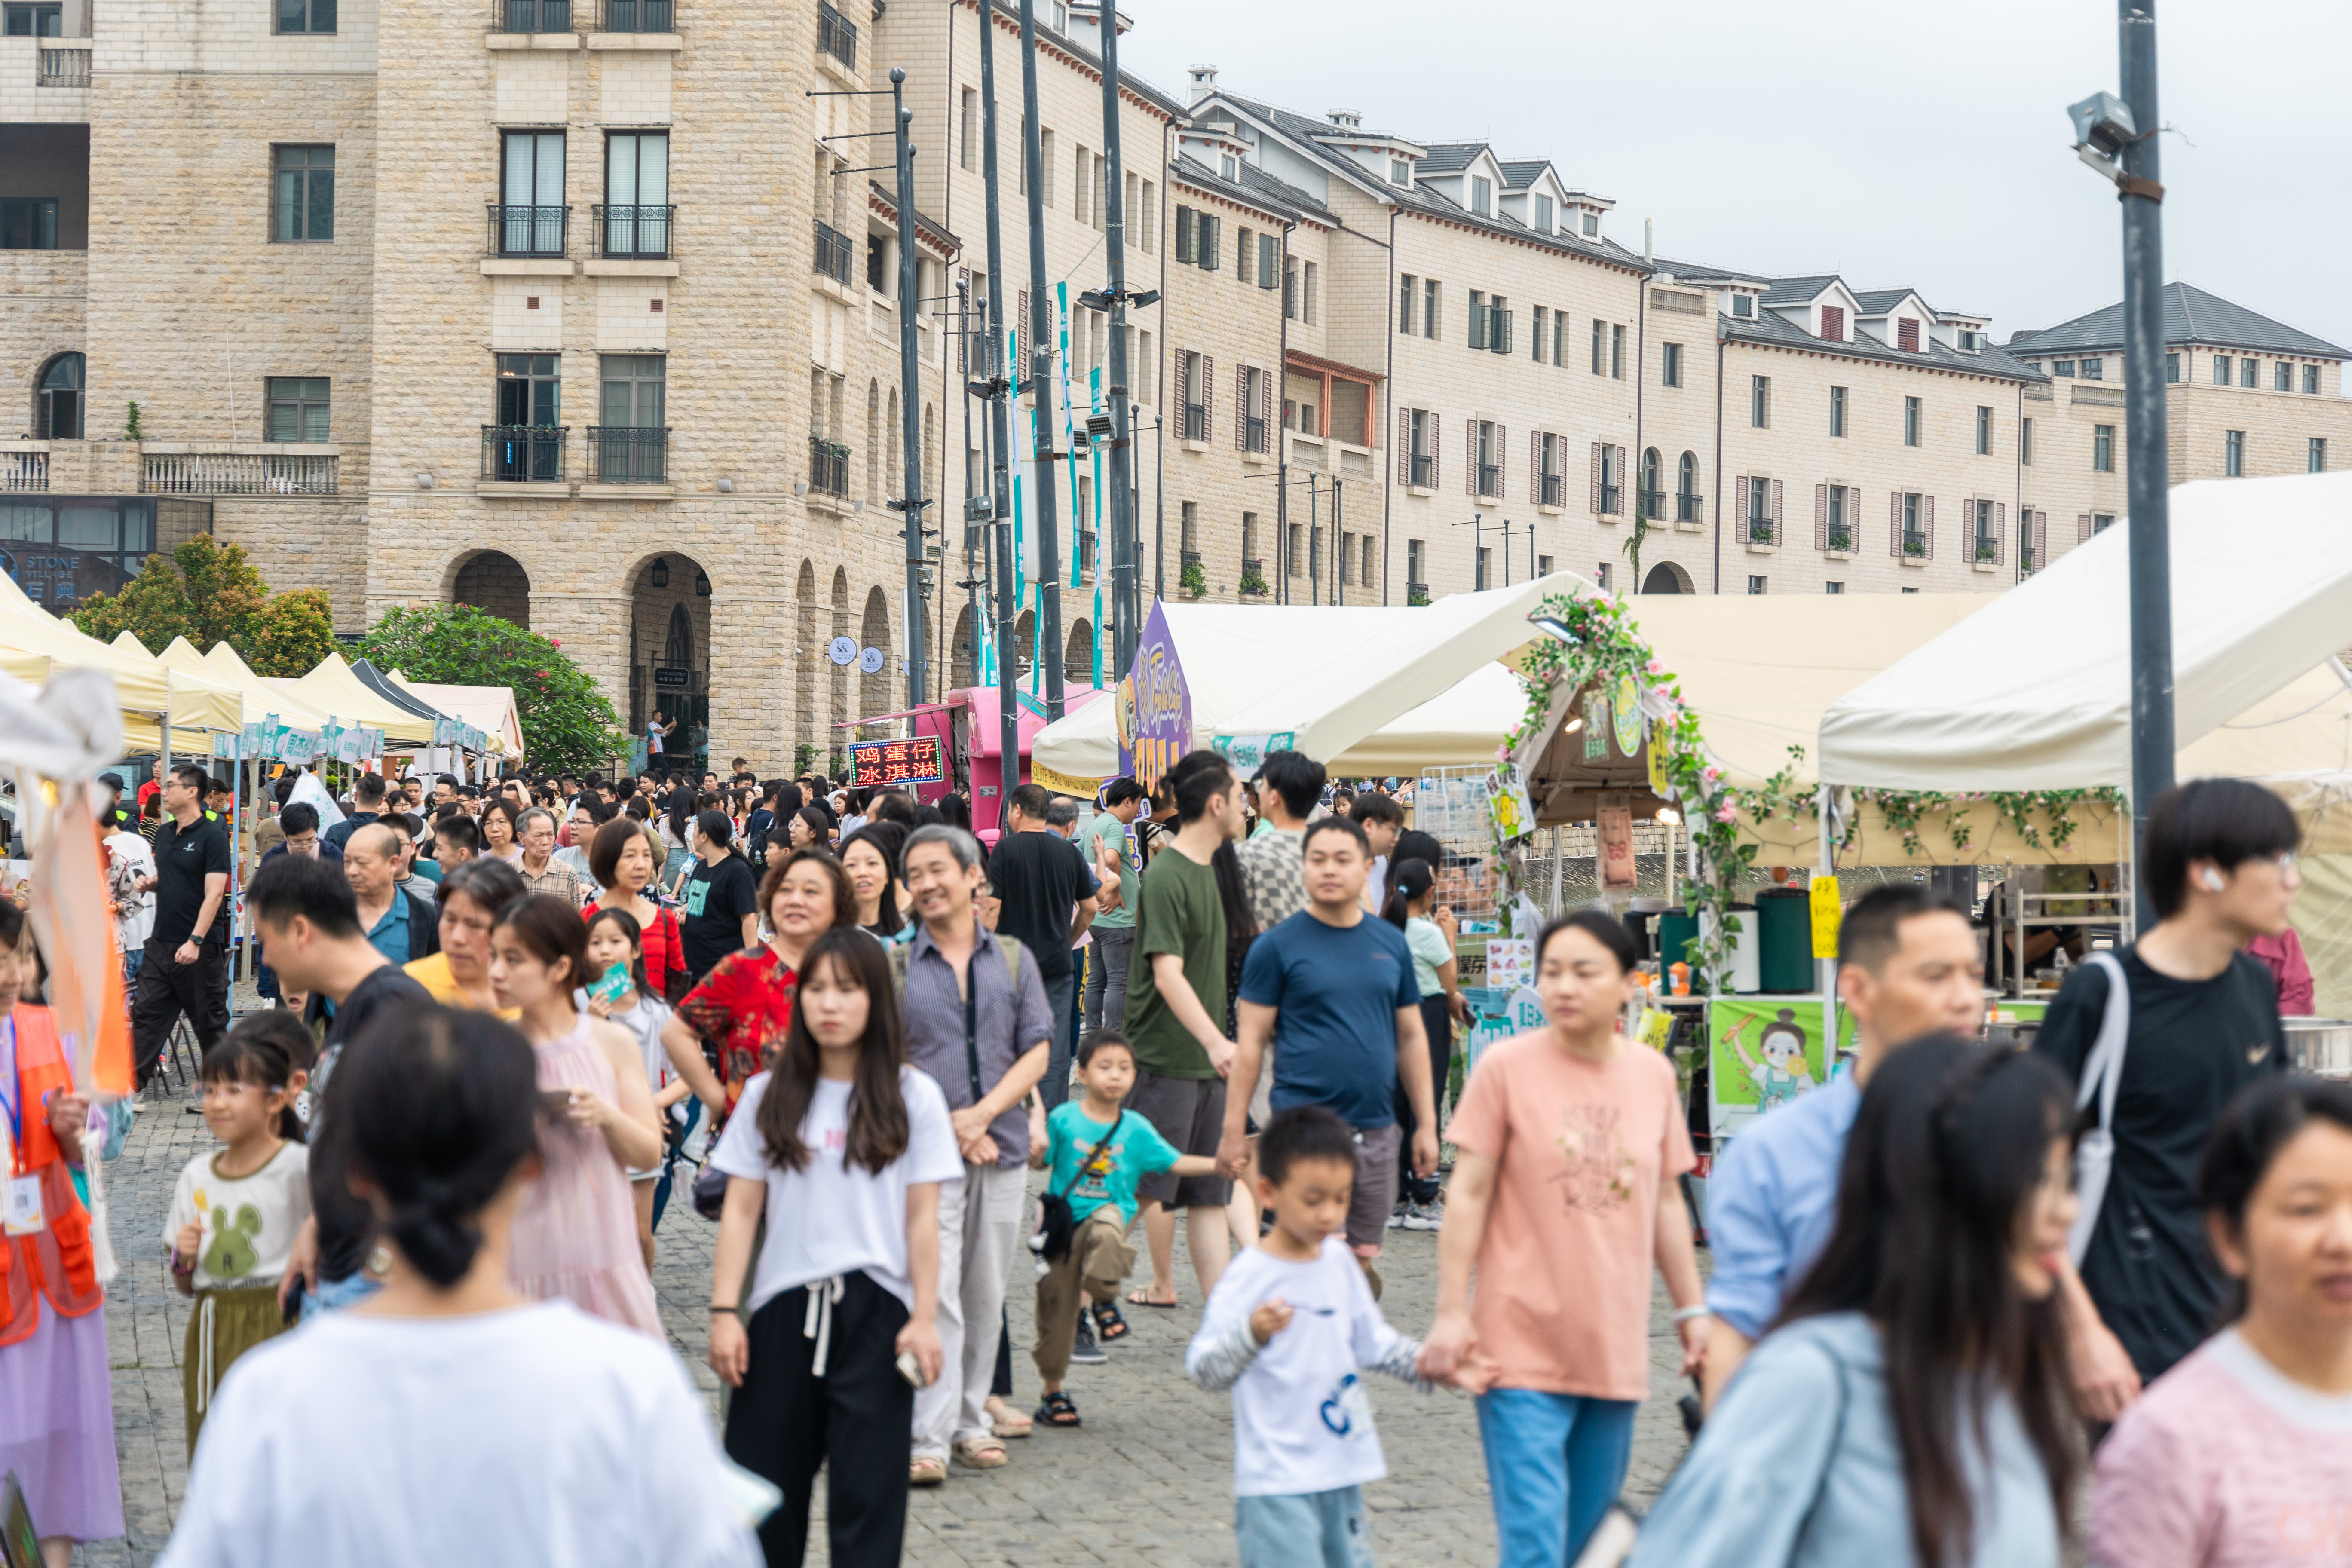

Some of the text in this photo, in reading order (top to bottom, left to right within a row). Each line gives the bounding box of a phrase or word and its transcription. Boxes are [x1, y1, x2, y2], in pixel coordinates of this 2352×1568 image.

[27, 557, 80, 569] STONE
[854, 743, 936, 763] 鸡蛋仔
[857, 761, 937, 782] 冰淇淋
[1032, 766, 1047, 782] SALUTE
